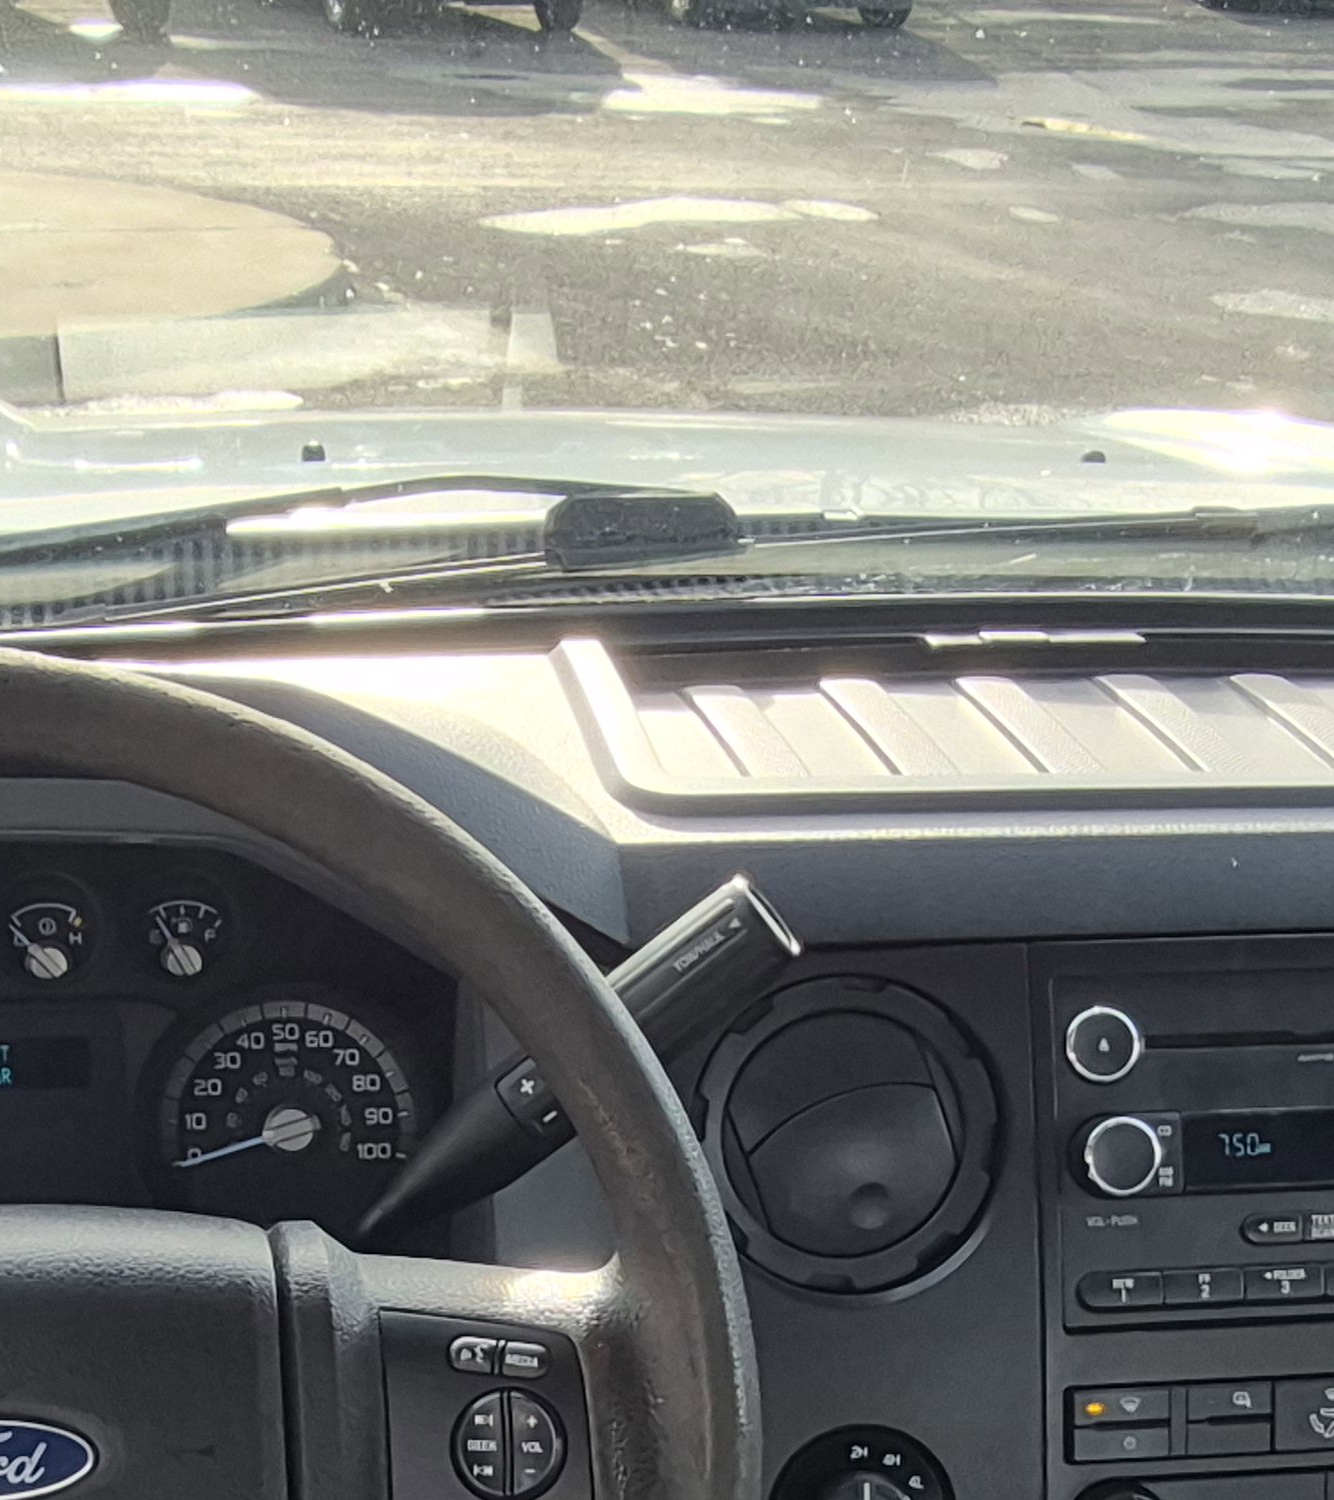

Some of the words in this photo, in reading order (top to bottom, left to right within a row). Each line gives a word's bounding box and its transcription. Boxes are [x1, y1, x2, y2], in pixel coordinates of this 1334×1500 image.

[69, 932, 82, 945] H
[235, 1032, 265, 1049] 40
[272, 1024, 299, 1040] 50
[305, 1030, 333, 1047] 60
[214, 1052, 241, 1069] 30
[333, 1048, 360, 1066] 70
[194, 1079, 222, 1096] 20
[352, 1074, 380, 1091] 80
[185, 1112, 207, 1130] 10
[364, 1108, 393, 1124] 90
[357, 1143, 392, 1159] 100
[1218, 1133, 1259, 1157] 750
[1201, 1284, 1210, 1299] 2
[1280, 1280, 1290, 1294] 3
[521, 1441, 543, 1453] VOL
